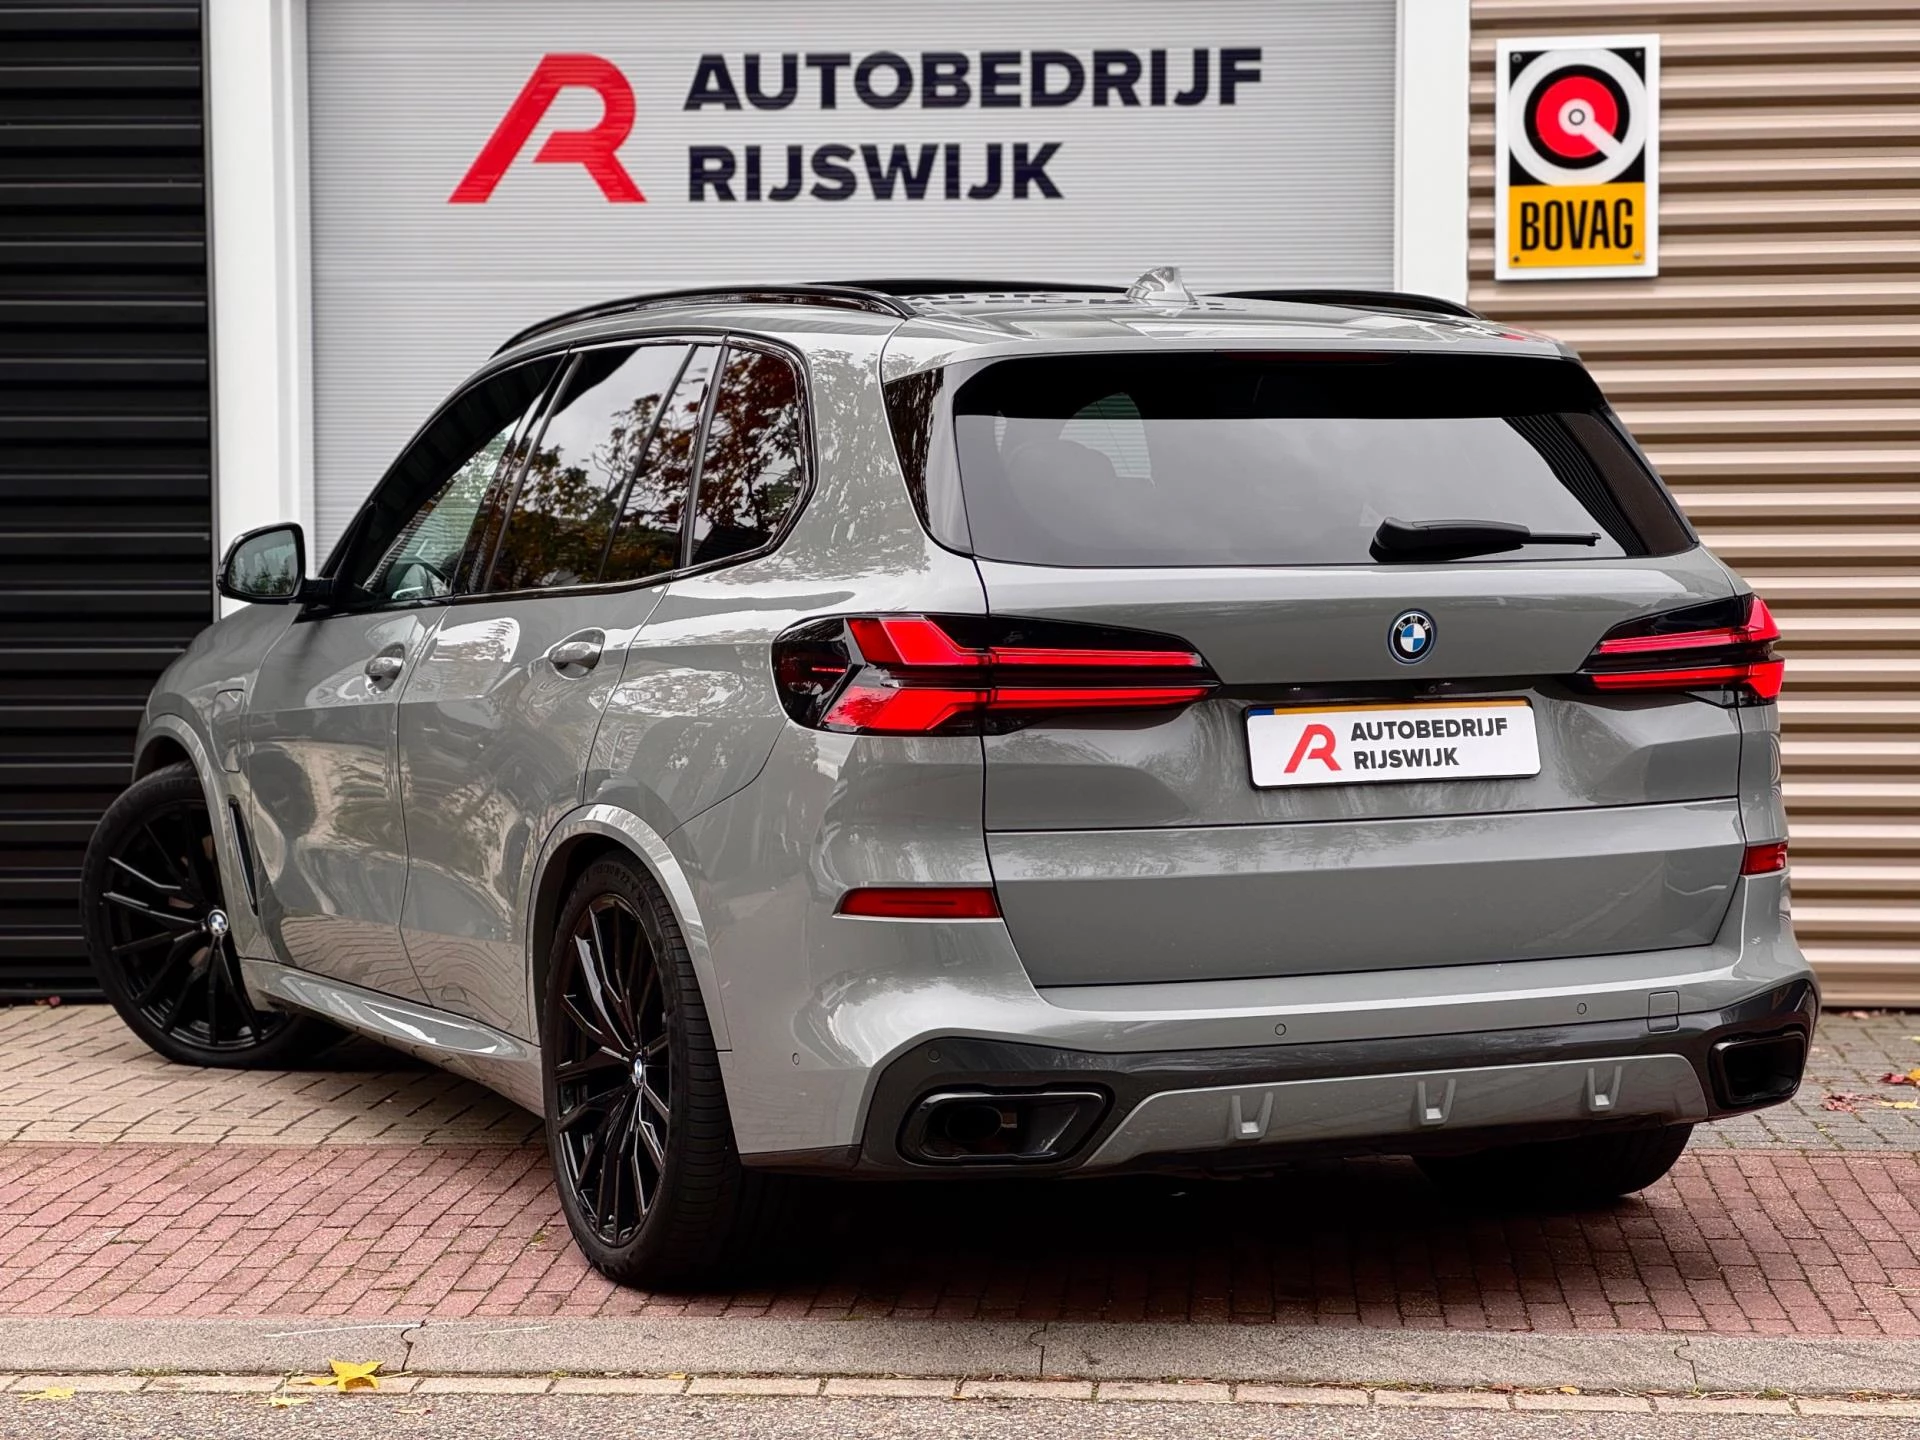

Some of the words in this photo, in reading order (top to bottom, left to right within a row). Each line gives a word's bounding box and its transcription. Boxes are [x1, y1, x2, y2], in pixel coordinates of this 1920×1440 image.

[683, 47, 1262, 111] AUTOBEDRIJF
[688, 142, 1064, 202] RIJSWIJK
[1520, 198, 1633, 251] BOVAG
[1396, 615, 1432, 632] BMW
[1350, 717, 1508, 742] AUTOBEDRIJF
[1353, 747, 1460, 770] RIJSWIJK
